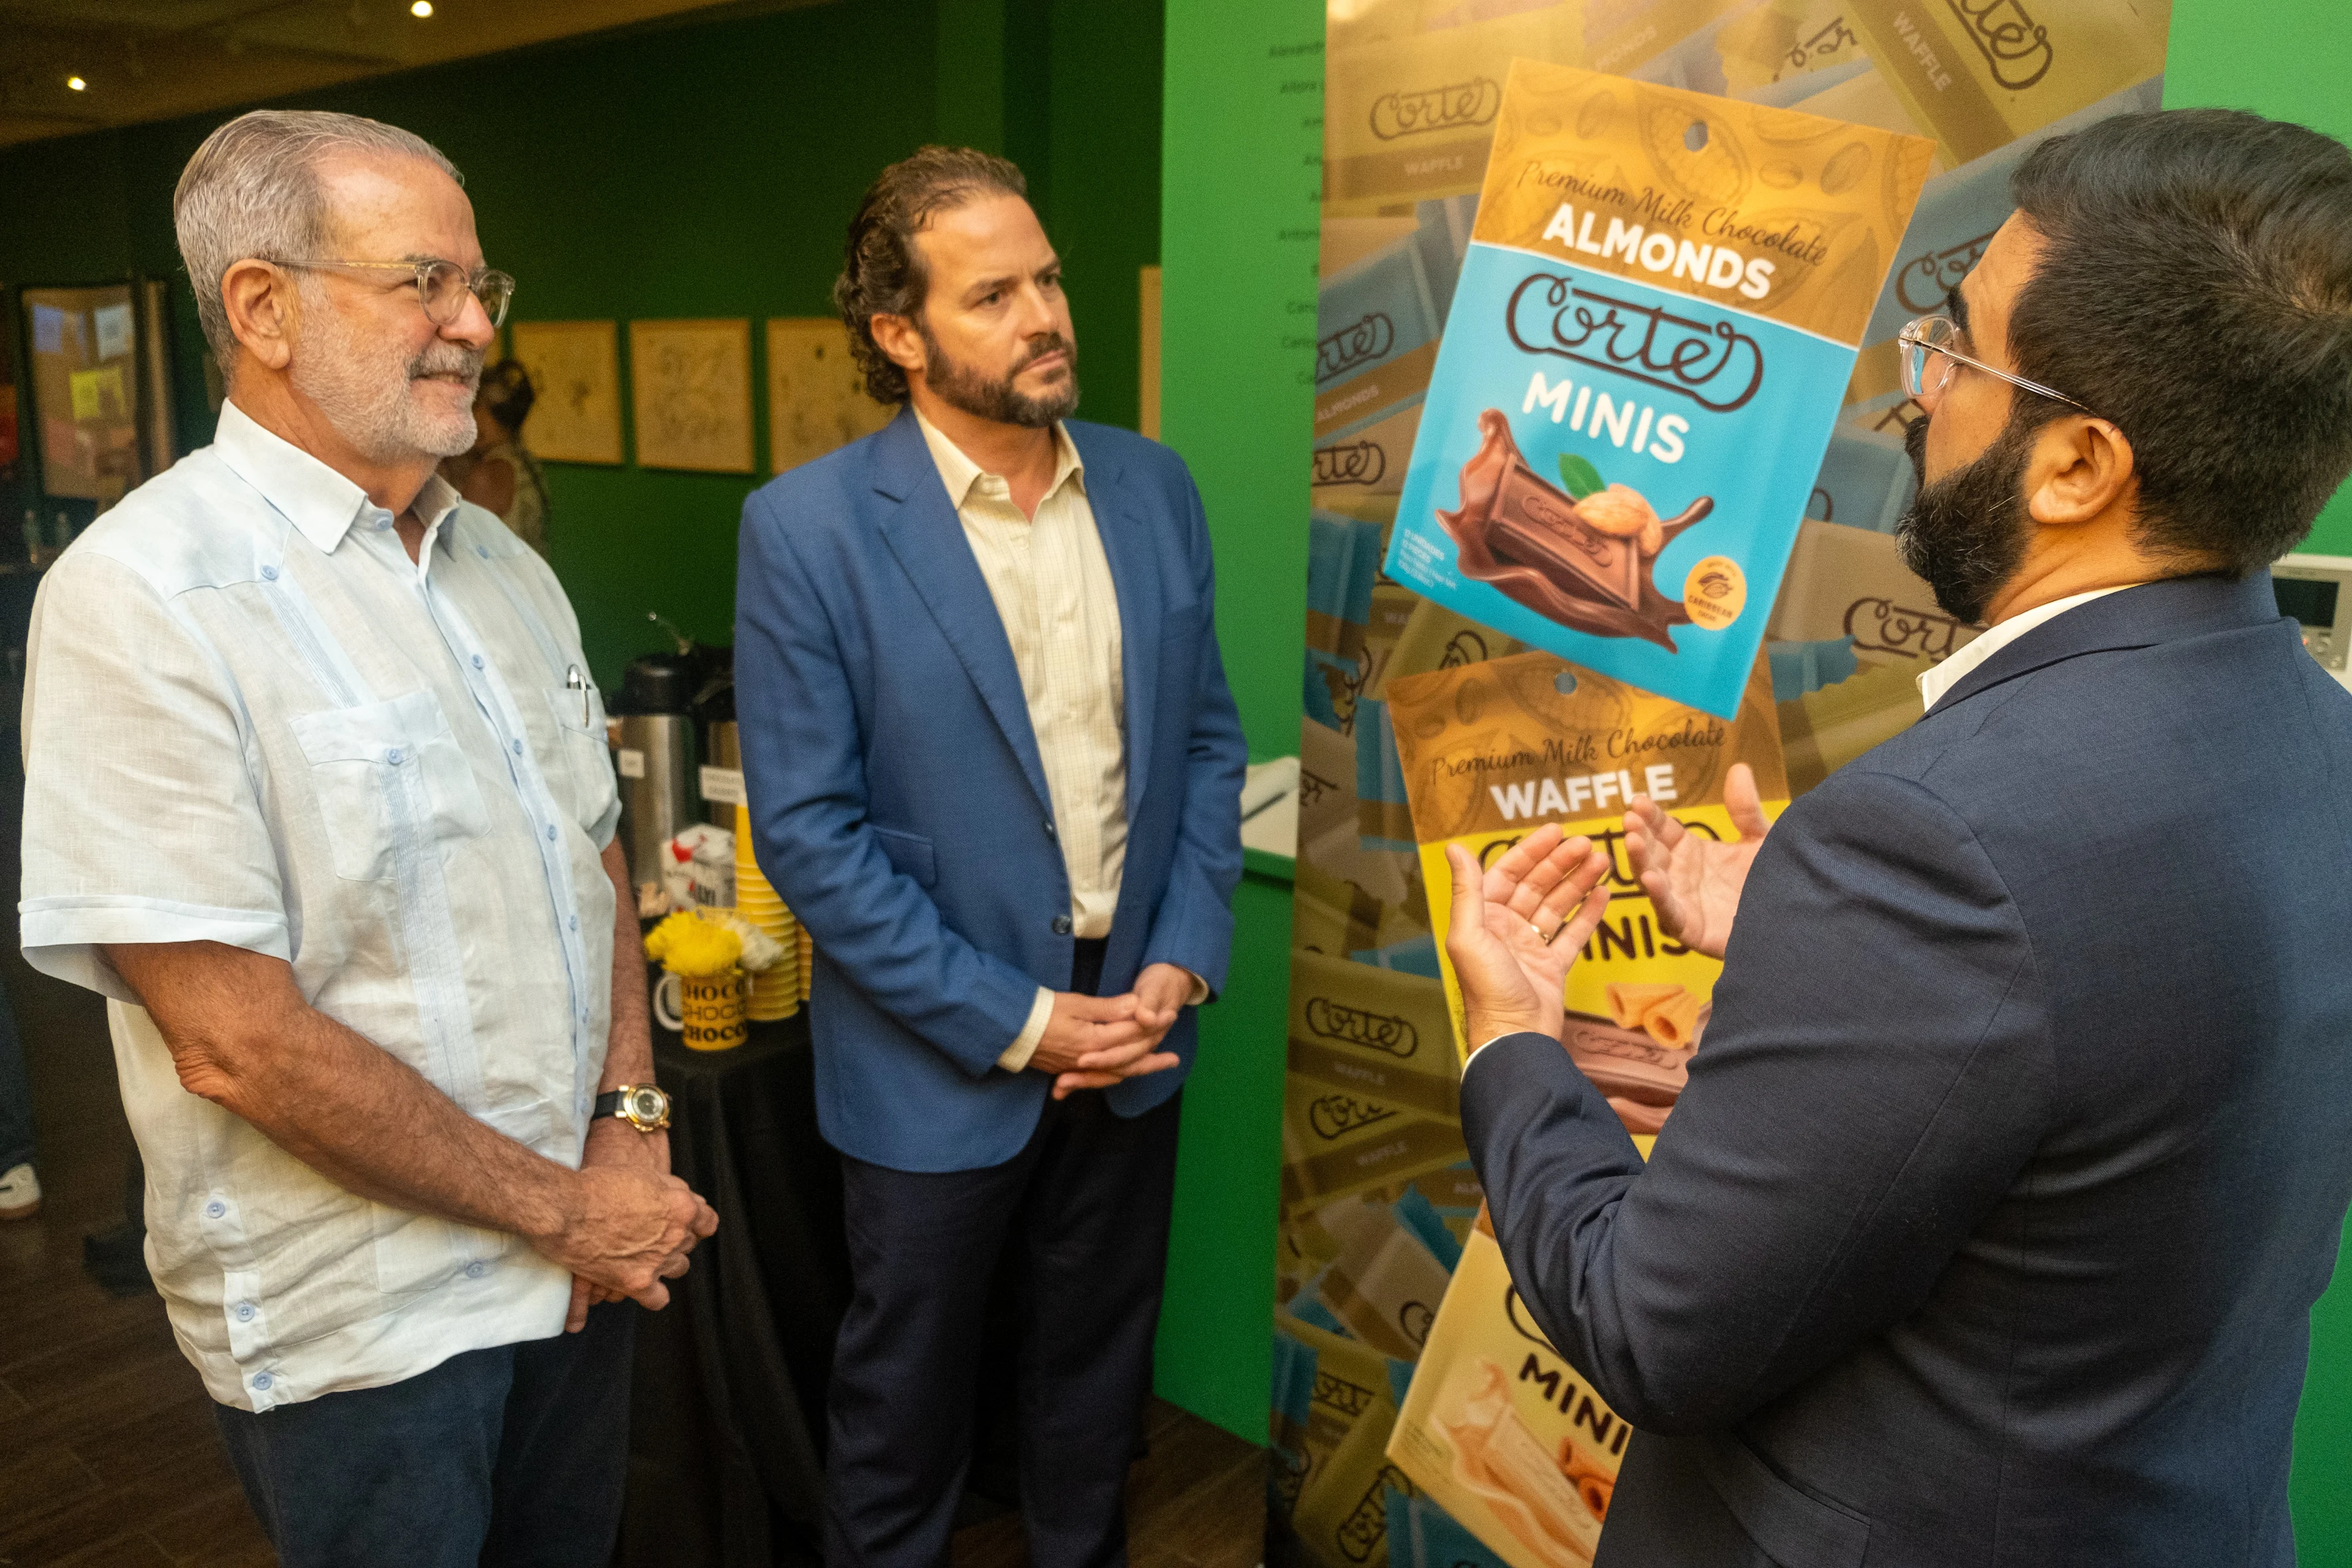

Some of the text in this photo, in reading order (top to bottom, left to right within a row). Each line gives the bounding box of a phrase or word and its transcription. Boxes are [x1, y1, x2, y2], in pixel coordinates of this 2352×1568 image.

[1893, 10, 1953, 92] WAFFLE
[1404, 154, 1463, 176] WAFFLE
[1517, 160, 1828, 268] Premium Milk Chocolate
[1542, 203, 1777, 300] ALMONDS
[1317, 384, 1379, 423] ALMONDS
[1521, 372, 1691, 464] MINIS
[1430, 722, 1726, 785] Premium Milk Chocolate
[1489, 763, 1678, 821] WAFFLE
[1333, 1062, 1386, 1086] WAFFLE
[1519, 1352, 1629, 1455] MINI
